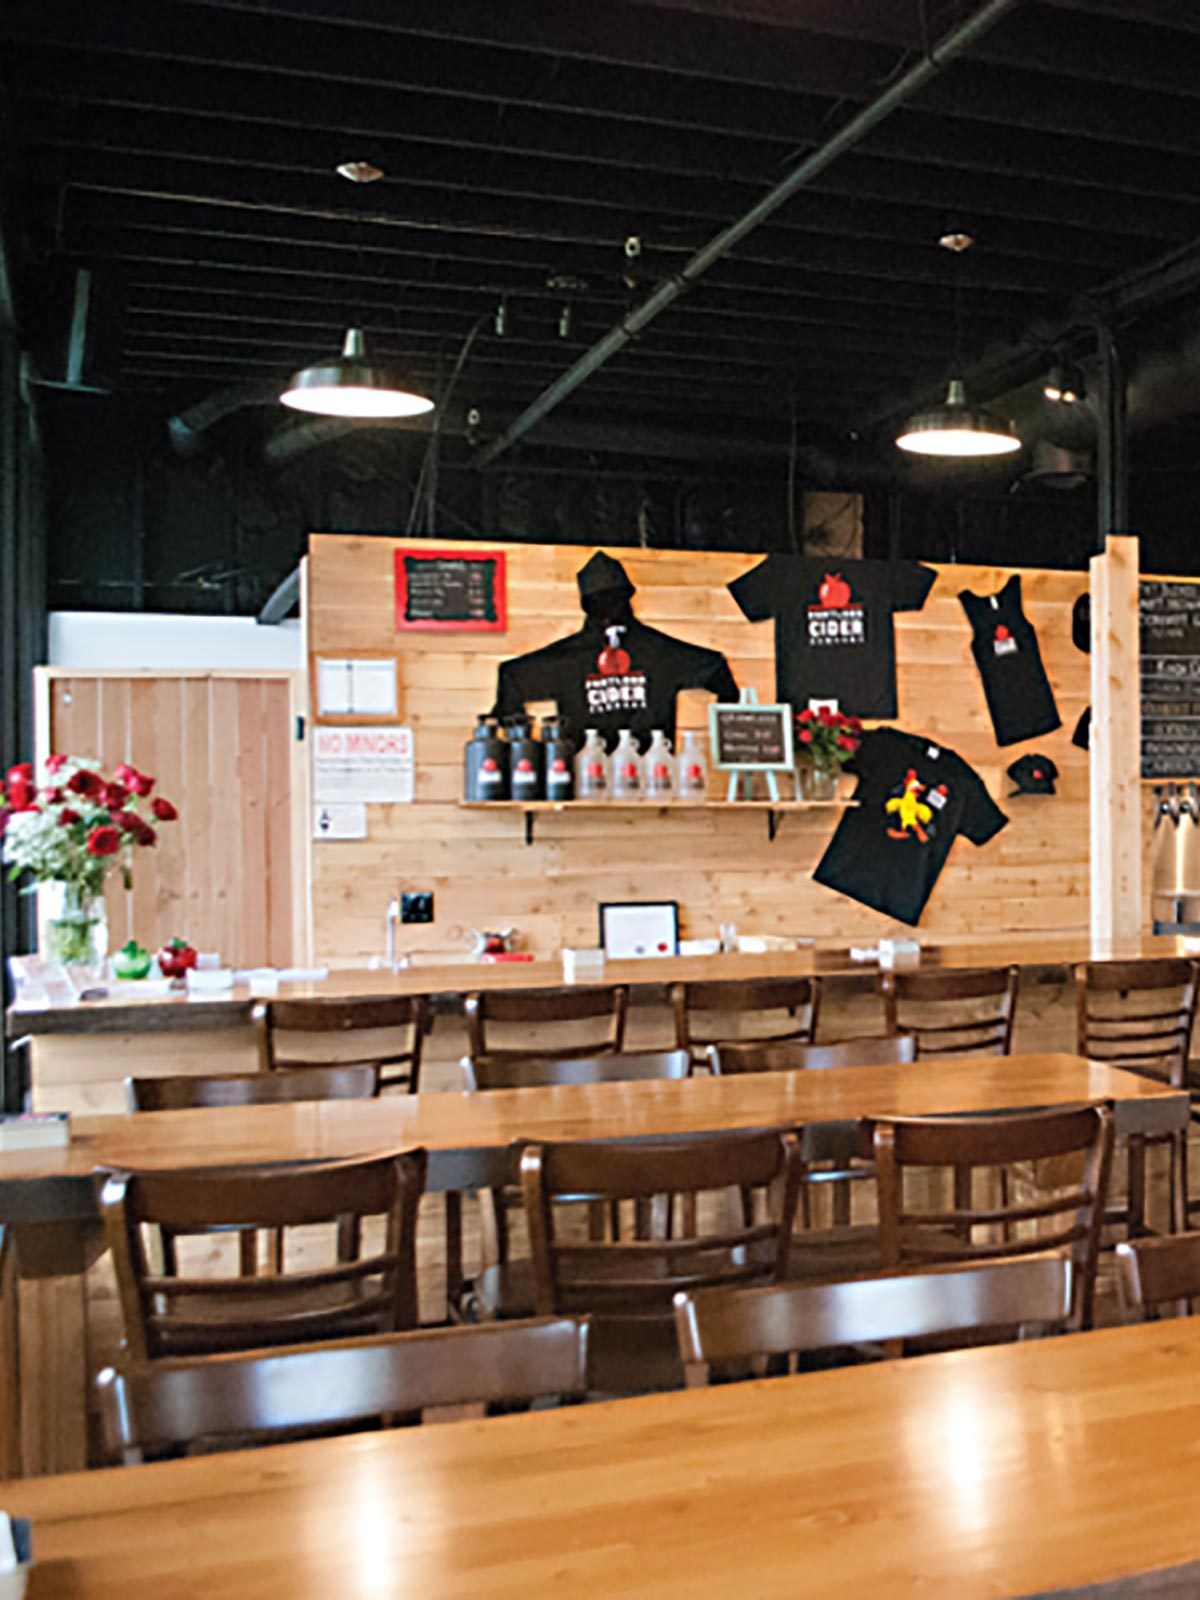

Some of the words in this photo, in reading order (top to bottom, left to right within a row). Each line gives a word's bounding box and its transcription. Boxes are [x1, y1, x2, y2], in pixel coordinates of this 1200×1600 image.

[808, 619, 864, 637] CIDER
[587, 686, 646, 706] CIDER
[318, 734, 342, 753] NO
[347, 733, 408, 754] MINORS
